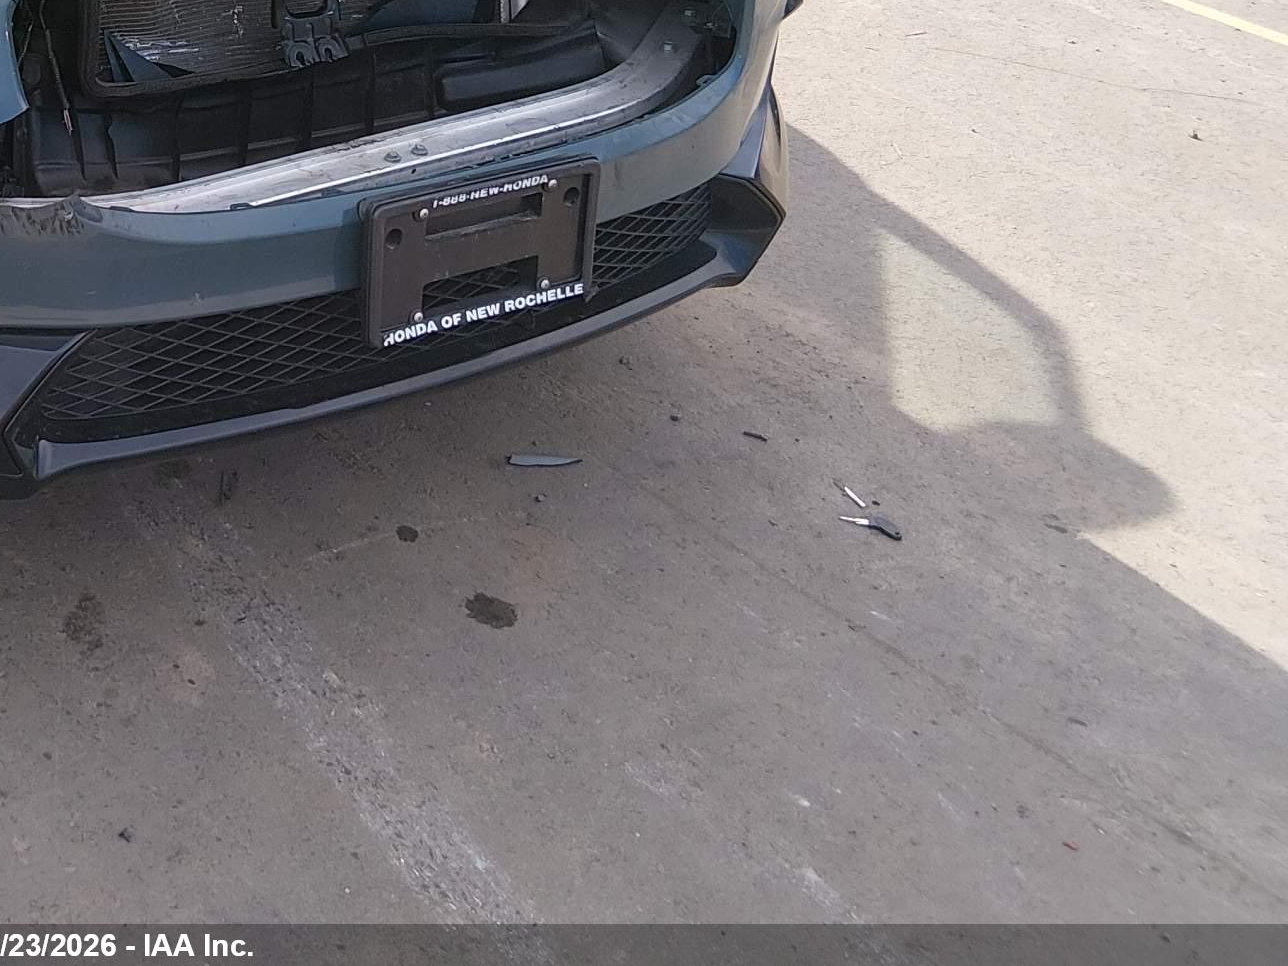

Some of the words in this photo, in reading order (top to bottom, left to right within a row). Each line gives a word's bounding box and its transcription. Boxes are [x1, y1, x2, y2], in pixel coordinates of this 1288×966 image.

[383, 320, 439, 346] HONDA
[441, 312, 463, 329] OF
[466, 302, 501, 322] NEW
[504, 283, 584, 313] ROCHELLE
